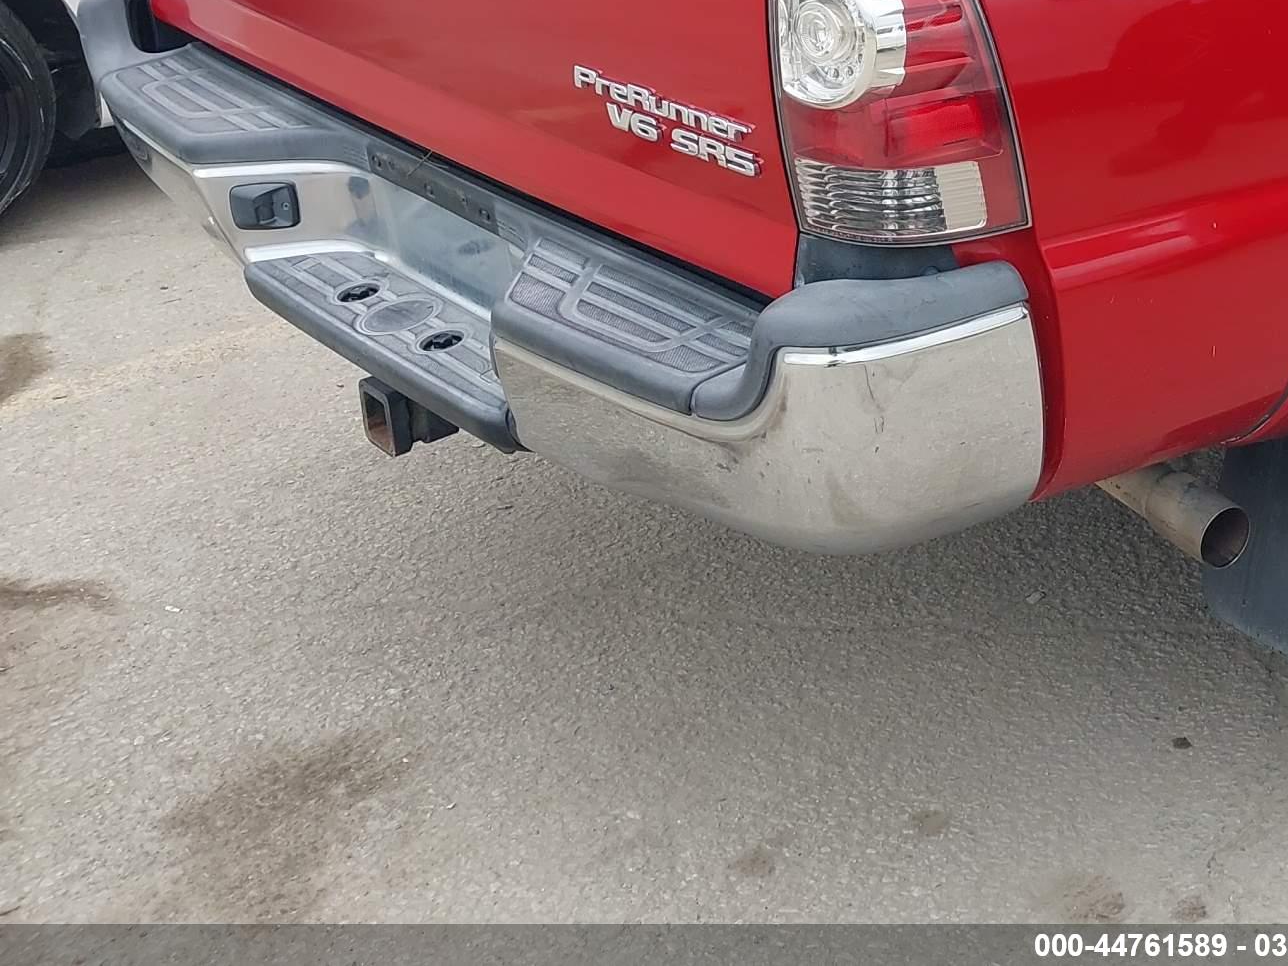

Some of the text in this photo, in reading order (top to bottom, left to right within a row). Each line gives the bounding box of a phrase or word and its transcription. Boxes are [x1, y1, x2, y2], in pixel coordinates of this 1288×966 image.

[573, 65, 752, 141] PreRunner
[606, 102, 760, 176] V6 SR5
